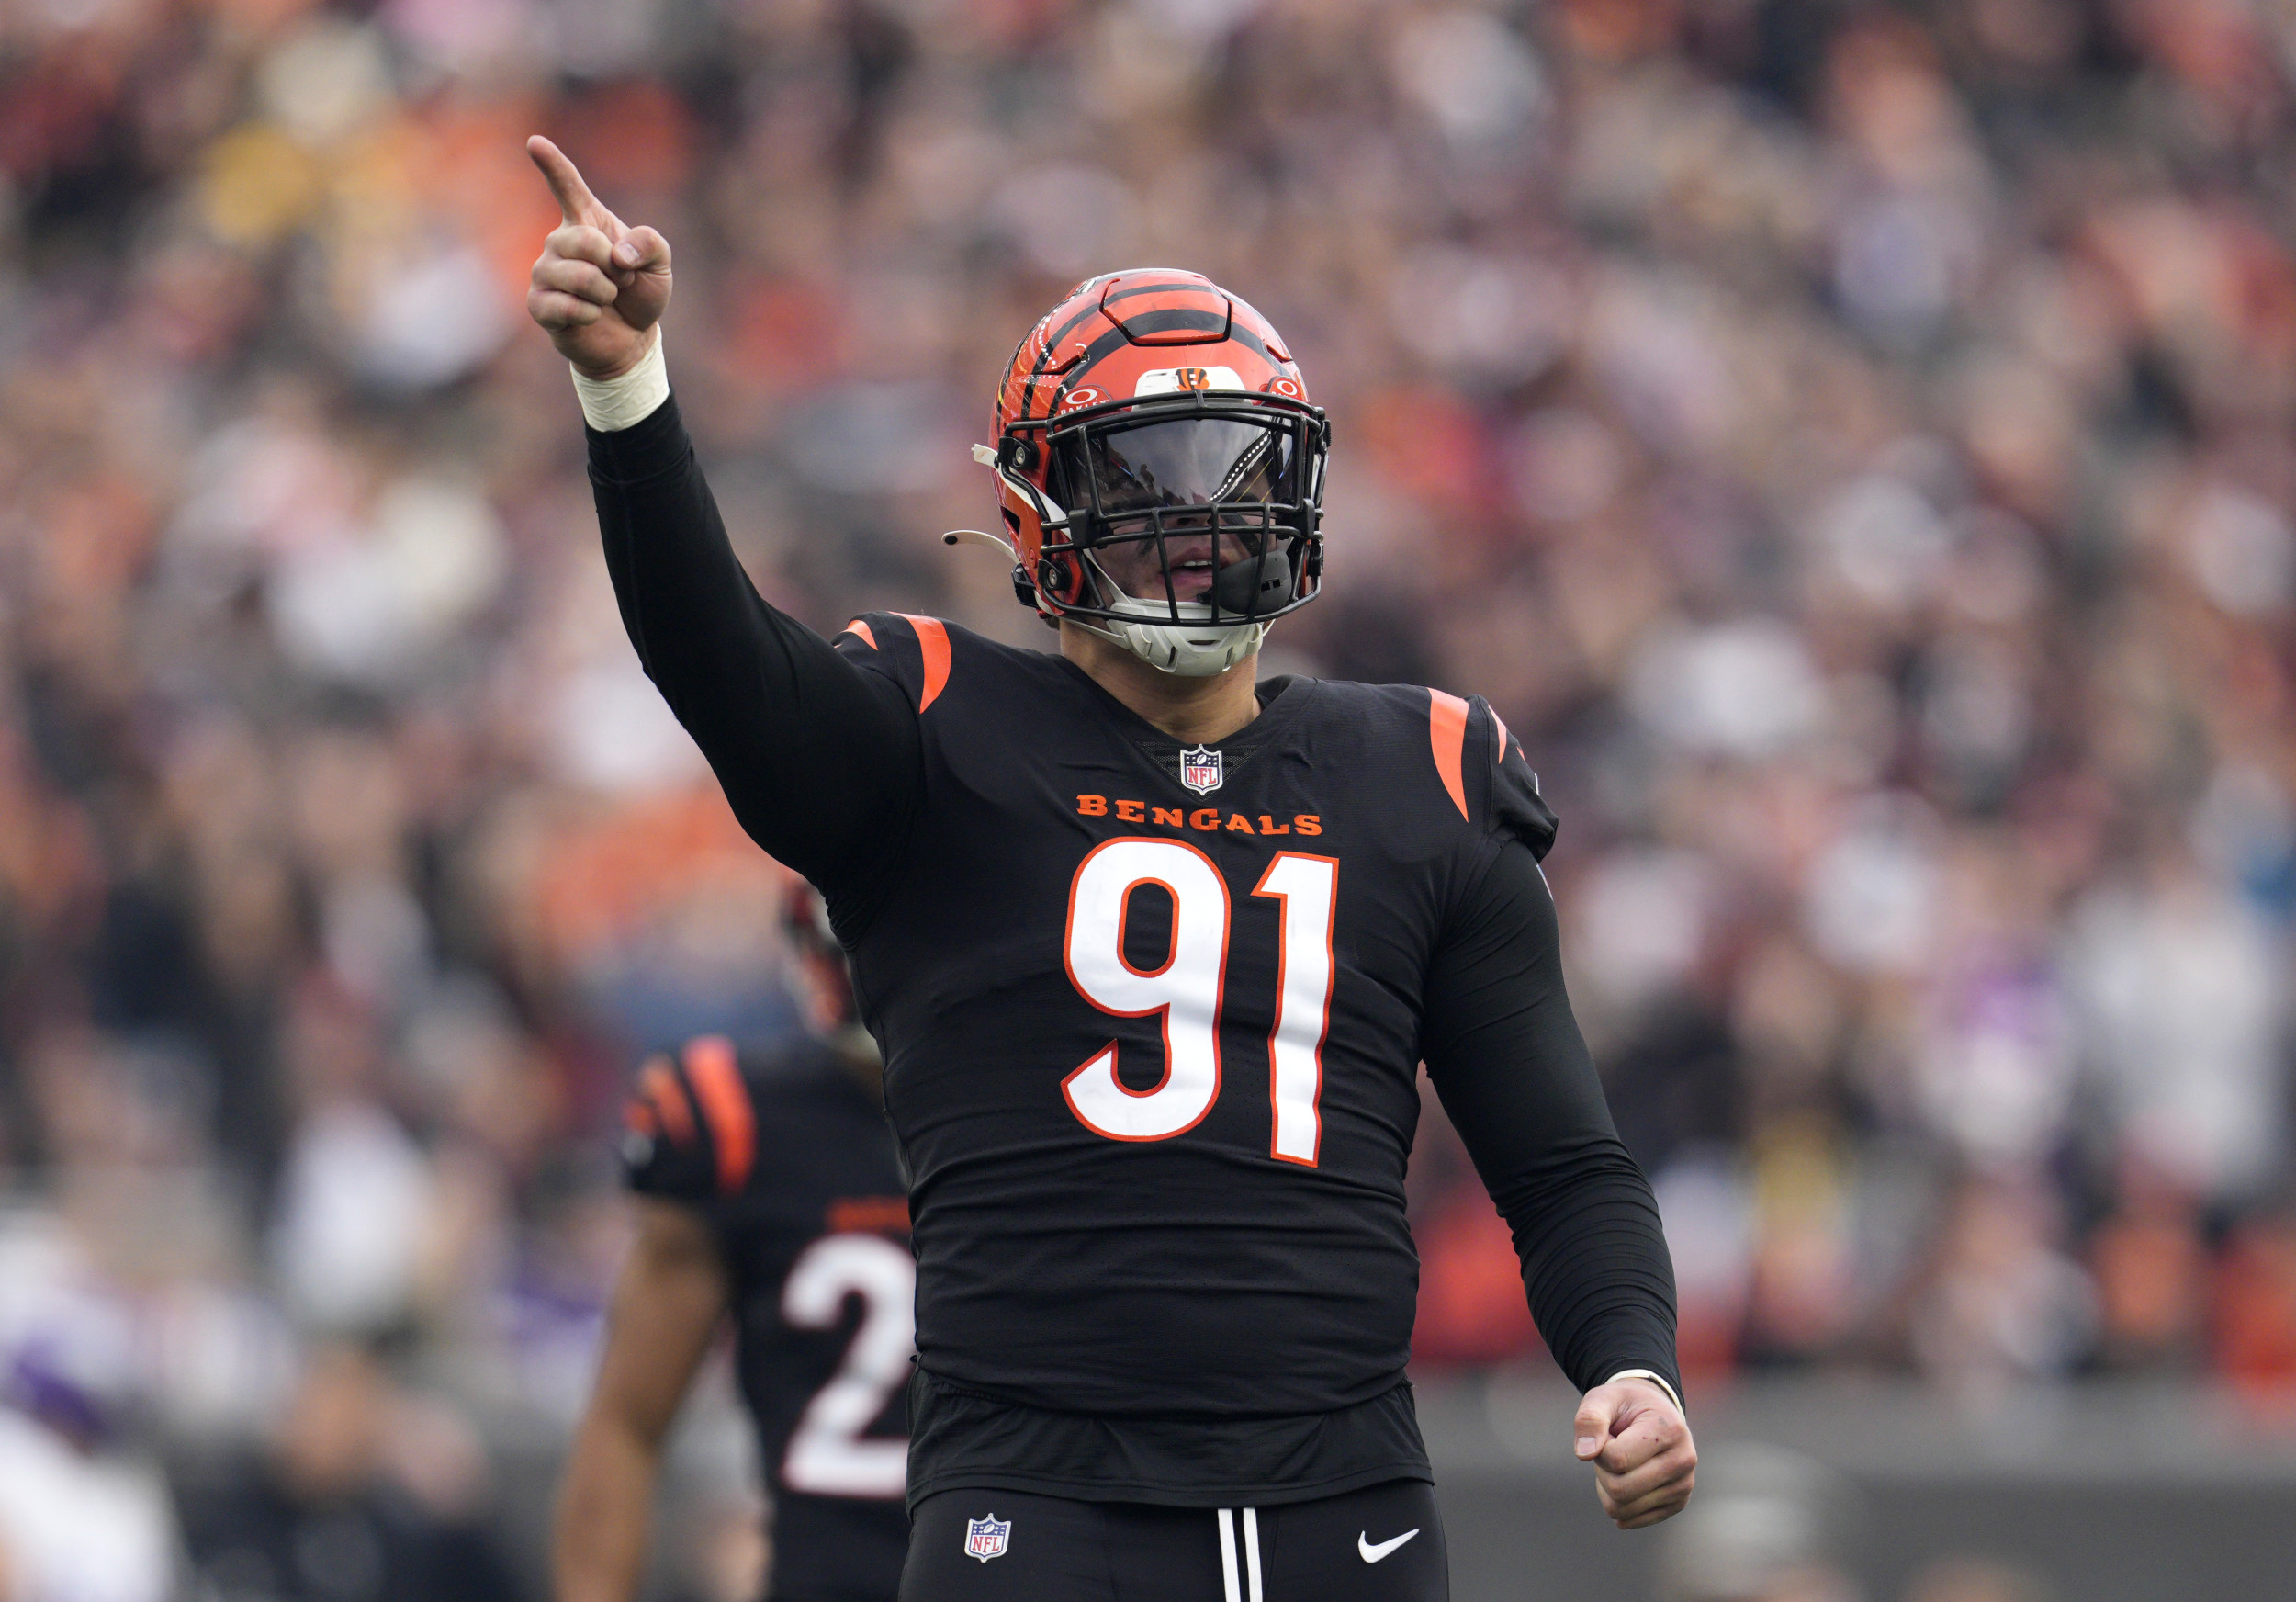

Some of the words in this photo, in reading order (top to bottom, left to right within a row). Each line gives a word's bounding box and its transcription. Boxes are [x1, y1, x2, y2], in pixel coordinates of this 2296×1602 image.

[1187, 767, 1217, 786] NFL
[1075, 794, 1322, 836] BENGALS
[1060, 836, 1340, 1168] 91
[972, 1536, 1000, 1553] NFL
